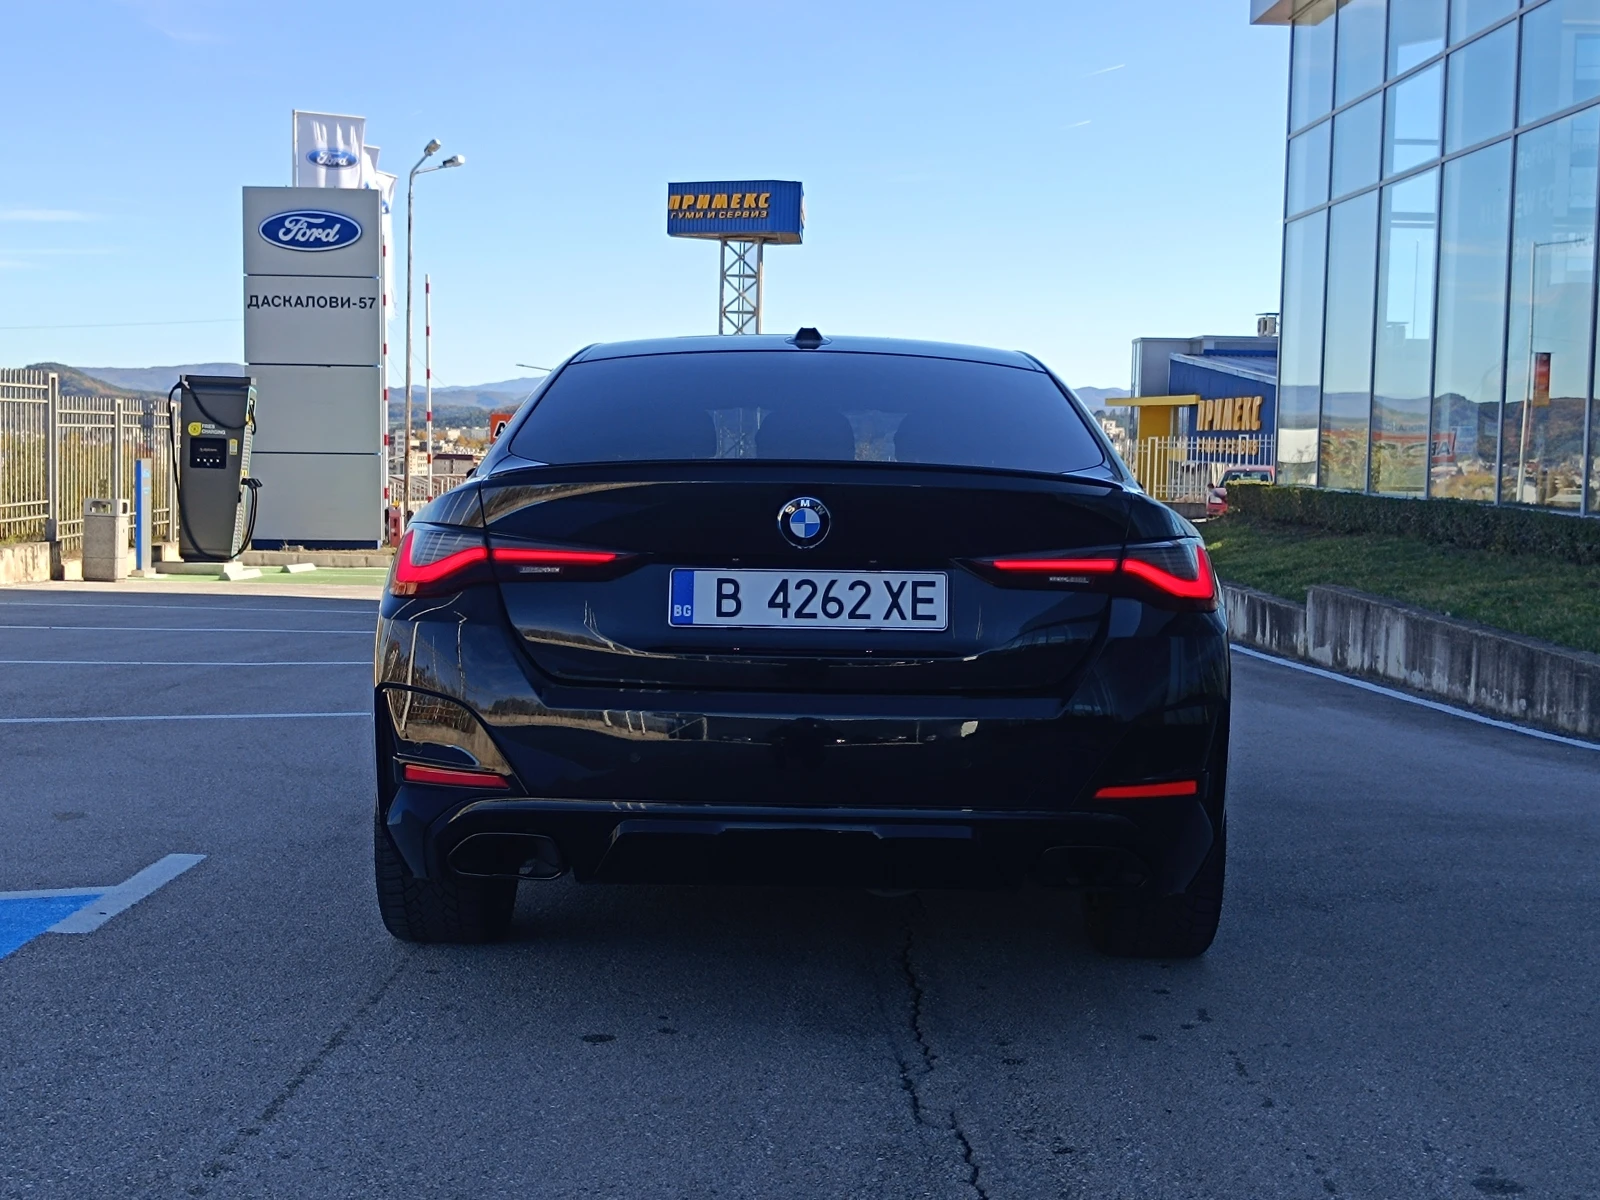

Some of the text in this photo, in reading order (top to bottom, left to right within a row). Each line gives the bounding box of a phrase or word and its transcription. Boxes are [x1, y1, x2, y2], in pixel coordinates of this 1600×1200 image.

[316, 150, 349, 166] Ford
[668, 193, 770, 210] ПРИМЕКС
[670, 210, 767, 219] ГУМИ И СЕРВИЗ
[278, 216, 341, 242] Ford
[247, 295, 377, 309] ДАСКАЛОВИ-57
[1196, 396, 1262, 431] ПРИМЕКС
[716, 577, 937, 621] B 4262 XE
[673, 604, 692, 617] BG
